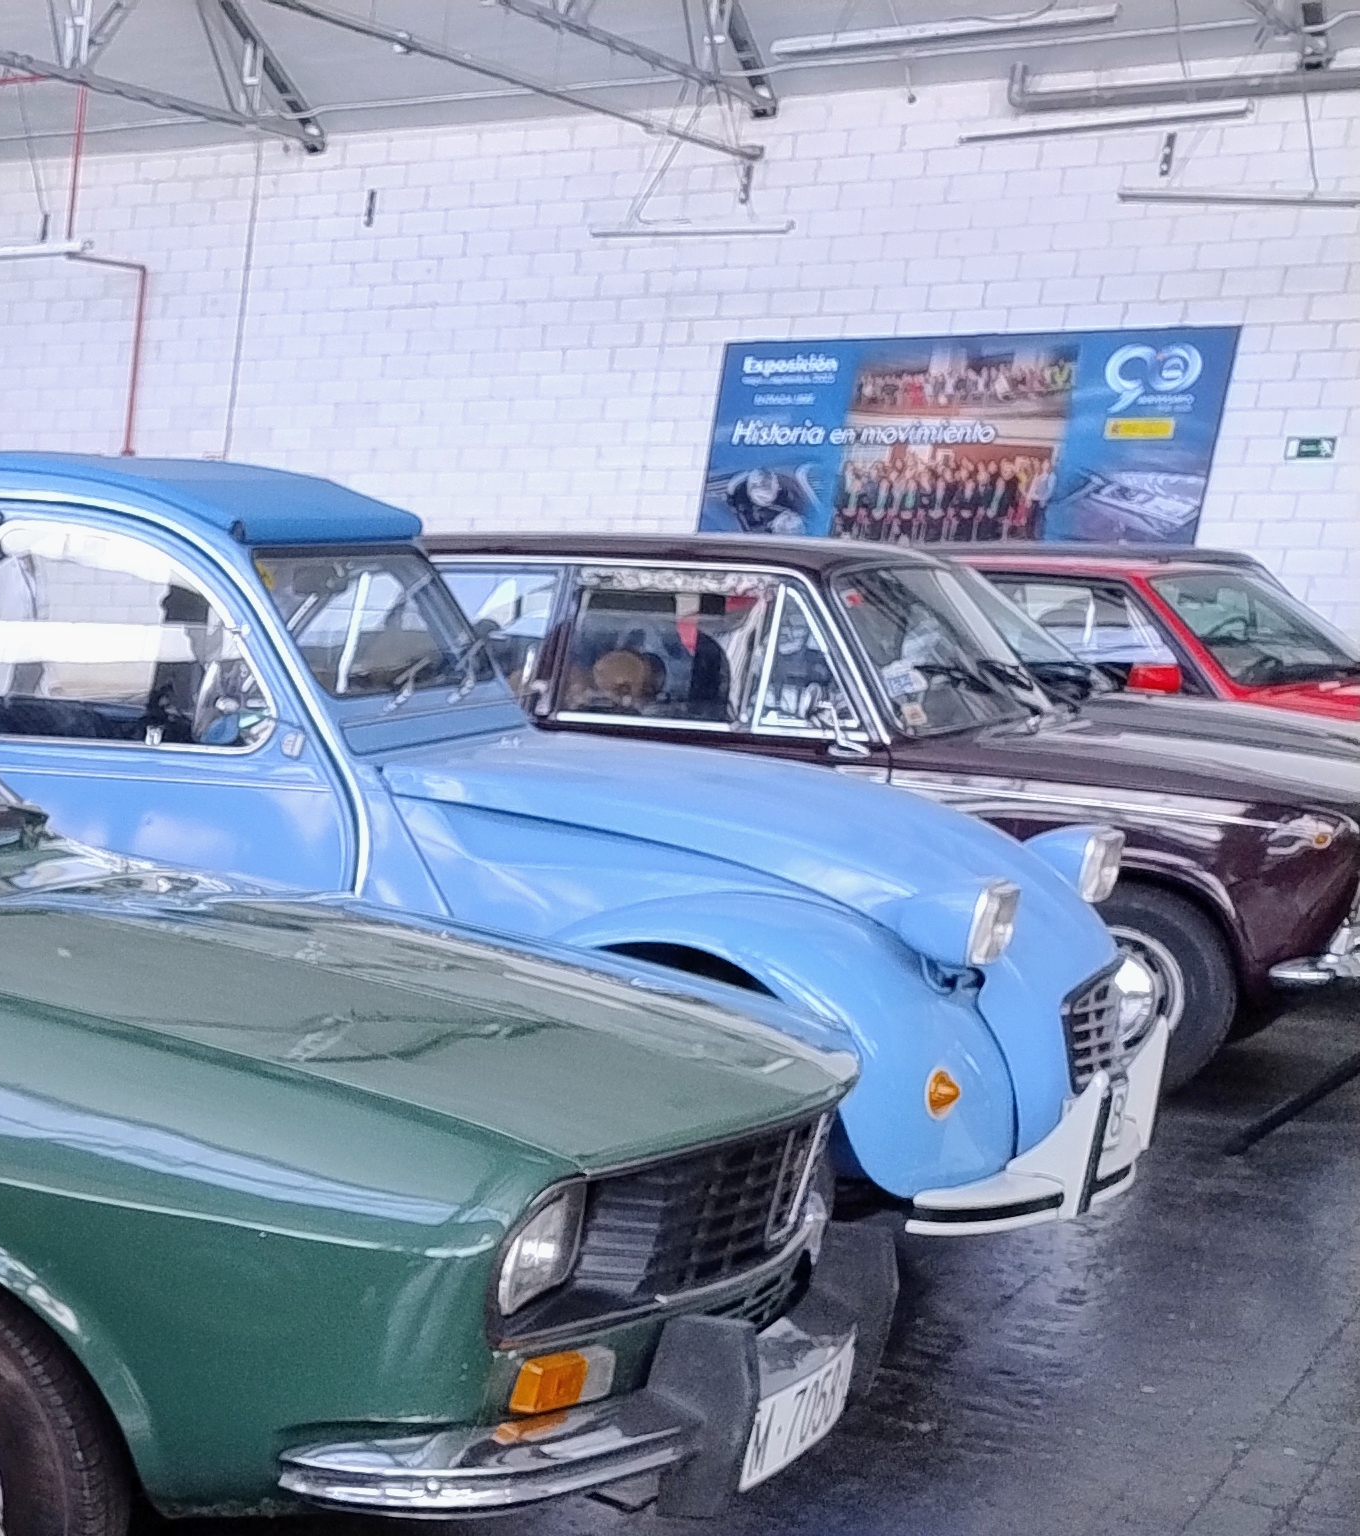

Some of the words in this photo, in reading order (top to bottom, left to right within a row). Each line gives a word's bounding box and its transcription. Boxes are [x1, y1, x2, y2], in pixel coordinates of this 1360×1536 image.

[743, 354, 838, 377] Exposición
[732, 419, 825, 445] Historia
[830, 427, 859, 445] en
[860, 419, 997, 445] movimiento
